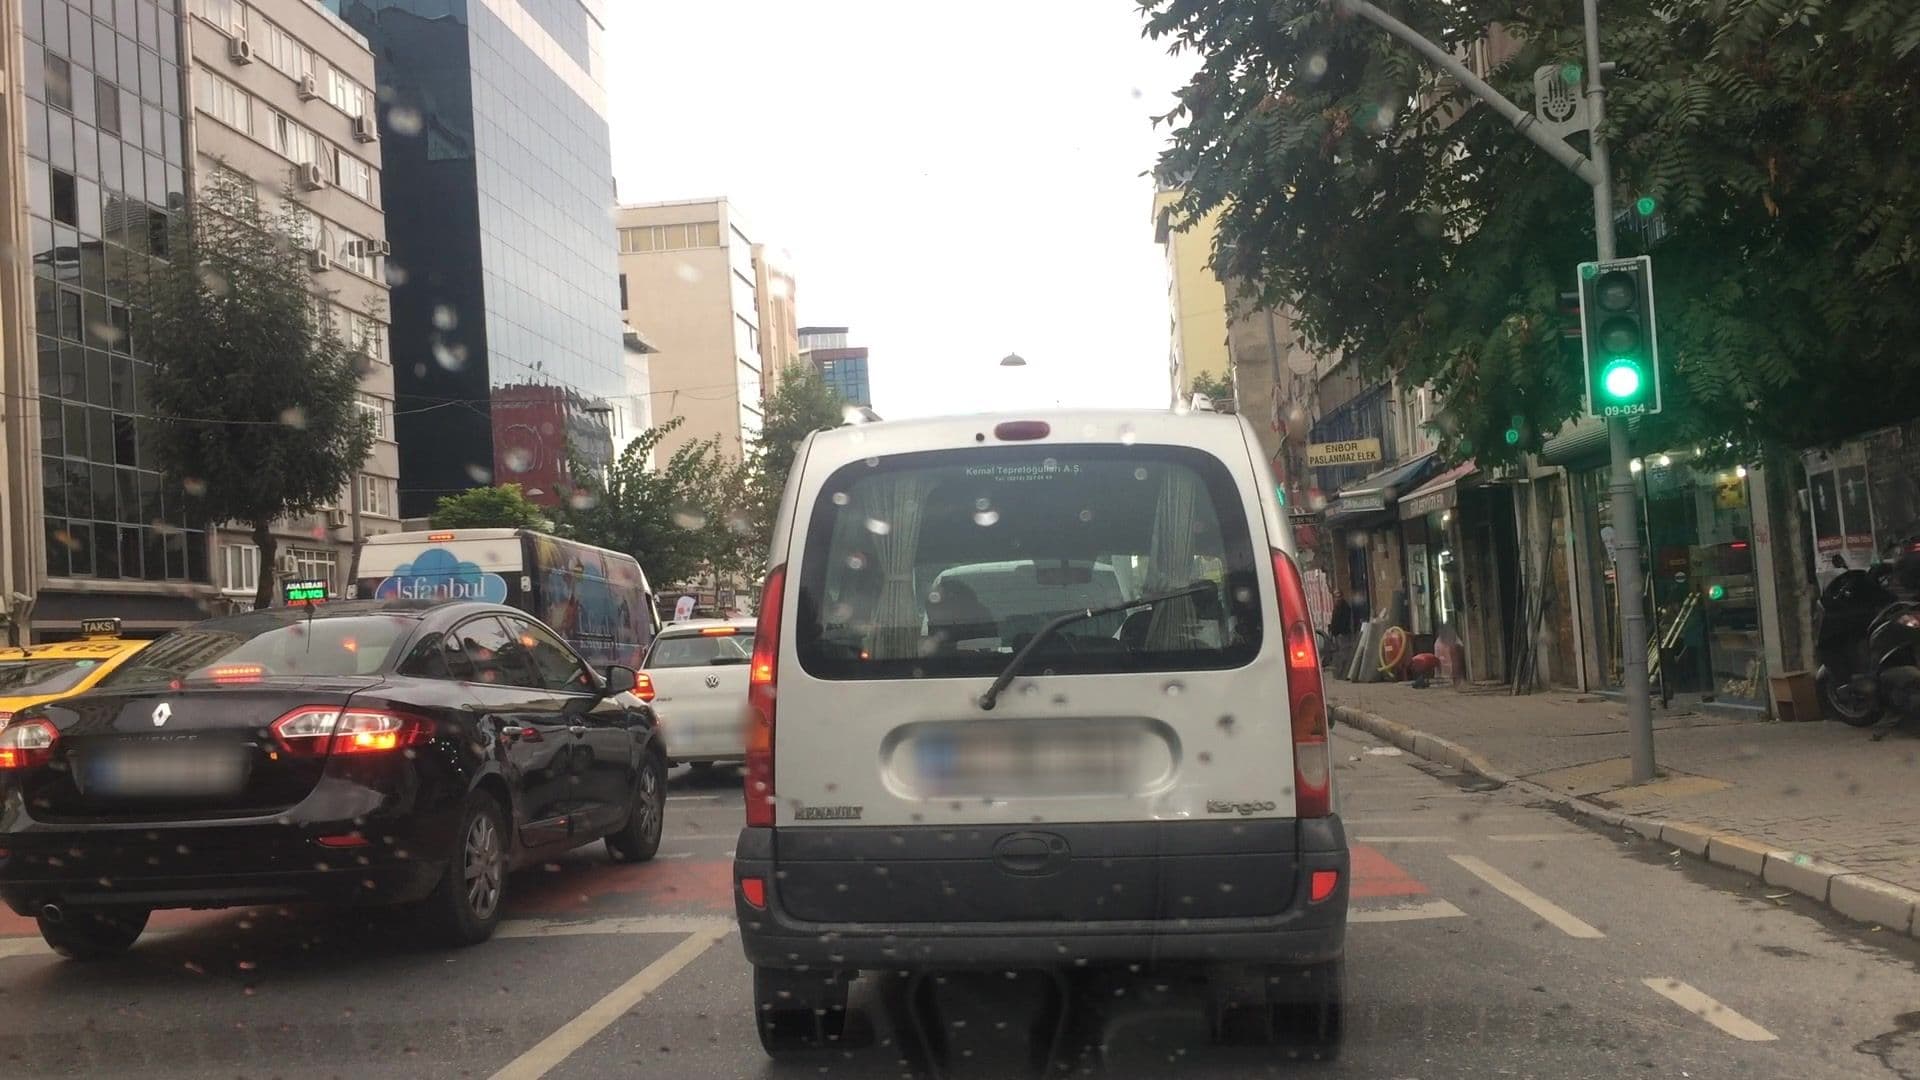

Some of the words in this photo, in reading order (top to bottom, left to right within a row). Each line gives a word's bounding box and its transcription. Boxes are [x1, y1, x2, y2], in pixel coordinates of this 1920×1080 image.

[1604, 403, 1645, 416] 09-034
[1325, 442, 1358, 454] ENBOR
[1309, 454, 1356, 465] PASLANMAZ
[1357, 453, 1376, 462] ELEK
[794, 805, 863, 820] RENAULT
